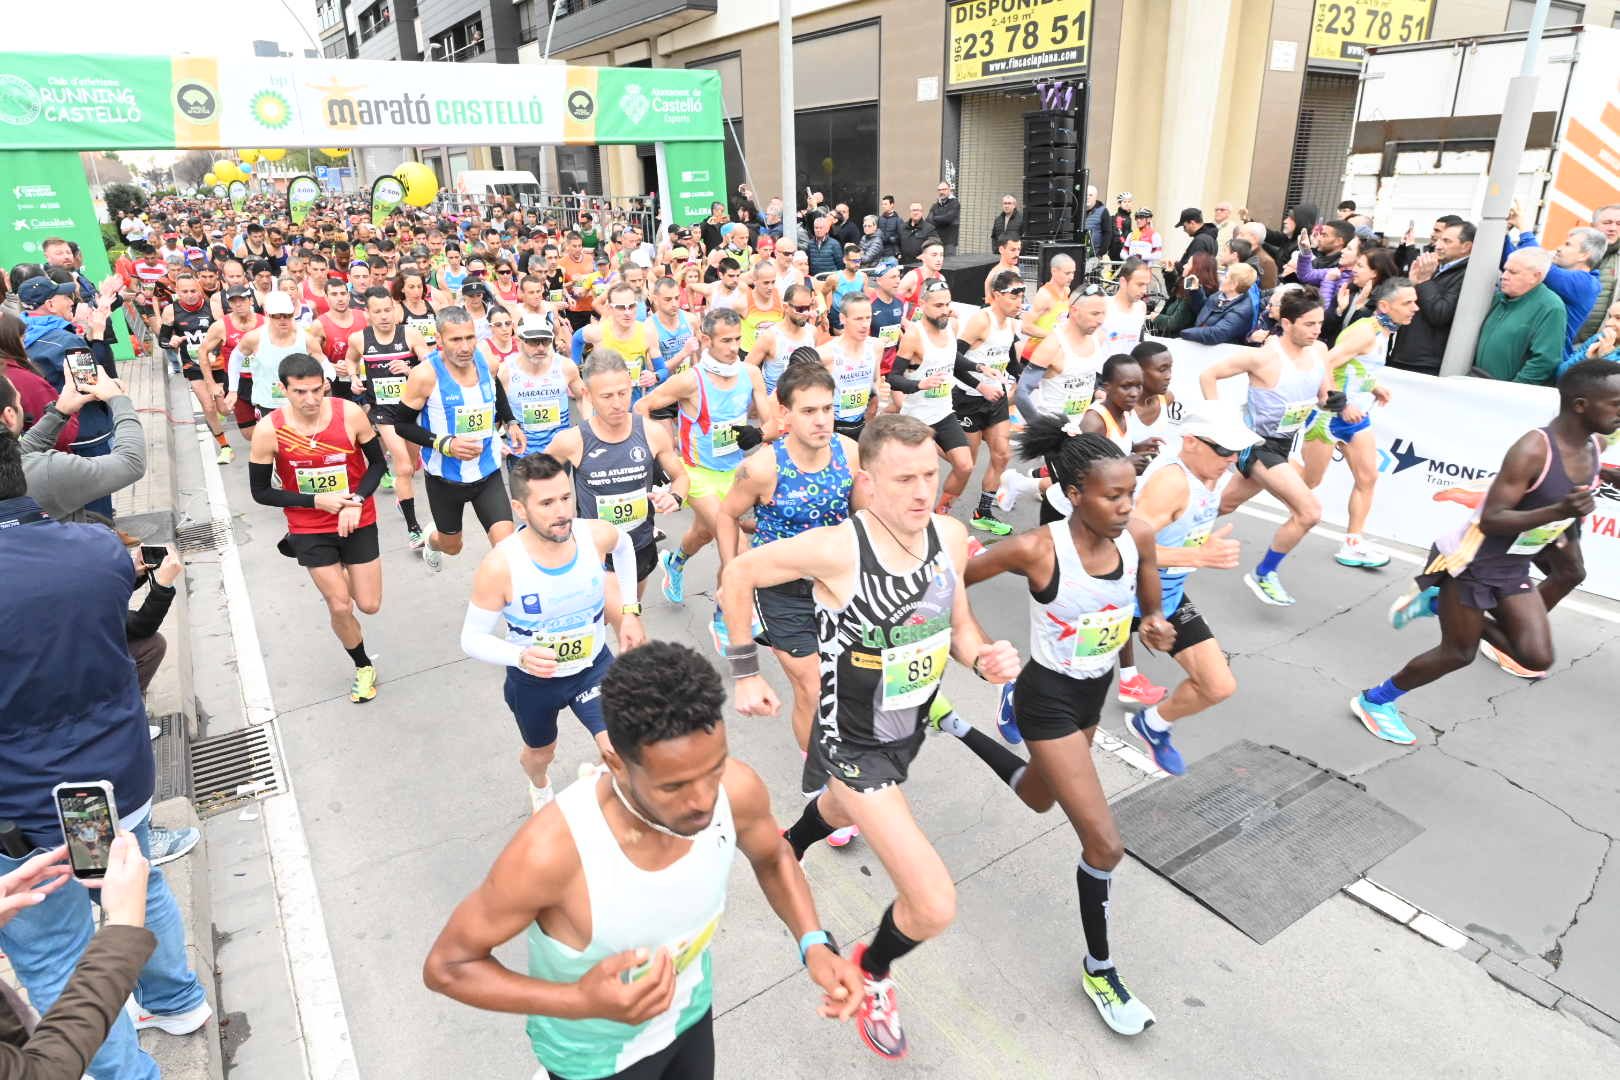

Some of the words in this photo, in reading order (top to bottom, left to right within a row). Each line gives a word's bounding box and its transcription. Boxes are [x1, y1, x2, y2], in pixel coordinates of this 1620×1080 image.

[992, 13, 1019, 27] 2.419
[1325, 3, 1356, 36] 23
[1366, 8, 1393, 41] 78
[1399, 14, 1426, 43] 51
[962, 29, 994, 61] 23
[1005, 20, 1040, 53] 78
[1050, 10, 1087, 45] 51
[954, 37, 963, 63] 964
[988, 49, 1077, 72] www.fincaslaplana.com
[40, 87, 137, 105] RUNNING
[327, 92, 431, 126] marató
[435, 95, 544, 126] CASTELLÓ
[651, 96, 704, 113] Castelló
[382, 384, 401, 395] 103
[517, 387, 560, 398] MARACENA
[850, 392, 862, 406] 98
[468, 413, 483, 428] 83
[534, 408, 549, 420] 92
[309, 475, 337, 489] 128
[613, 503, 633, 519] 99
[908, 655, 933, 682] 89
